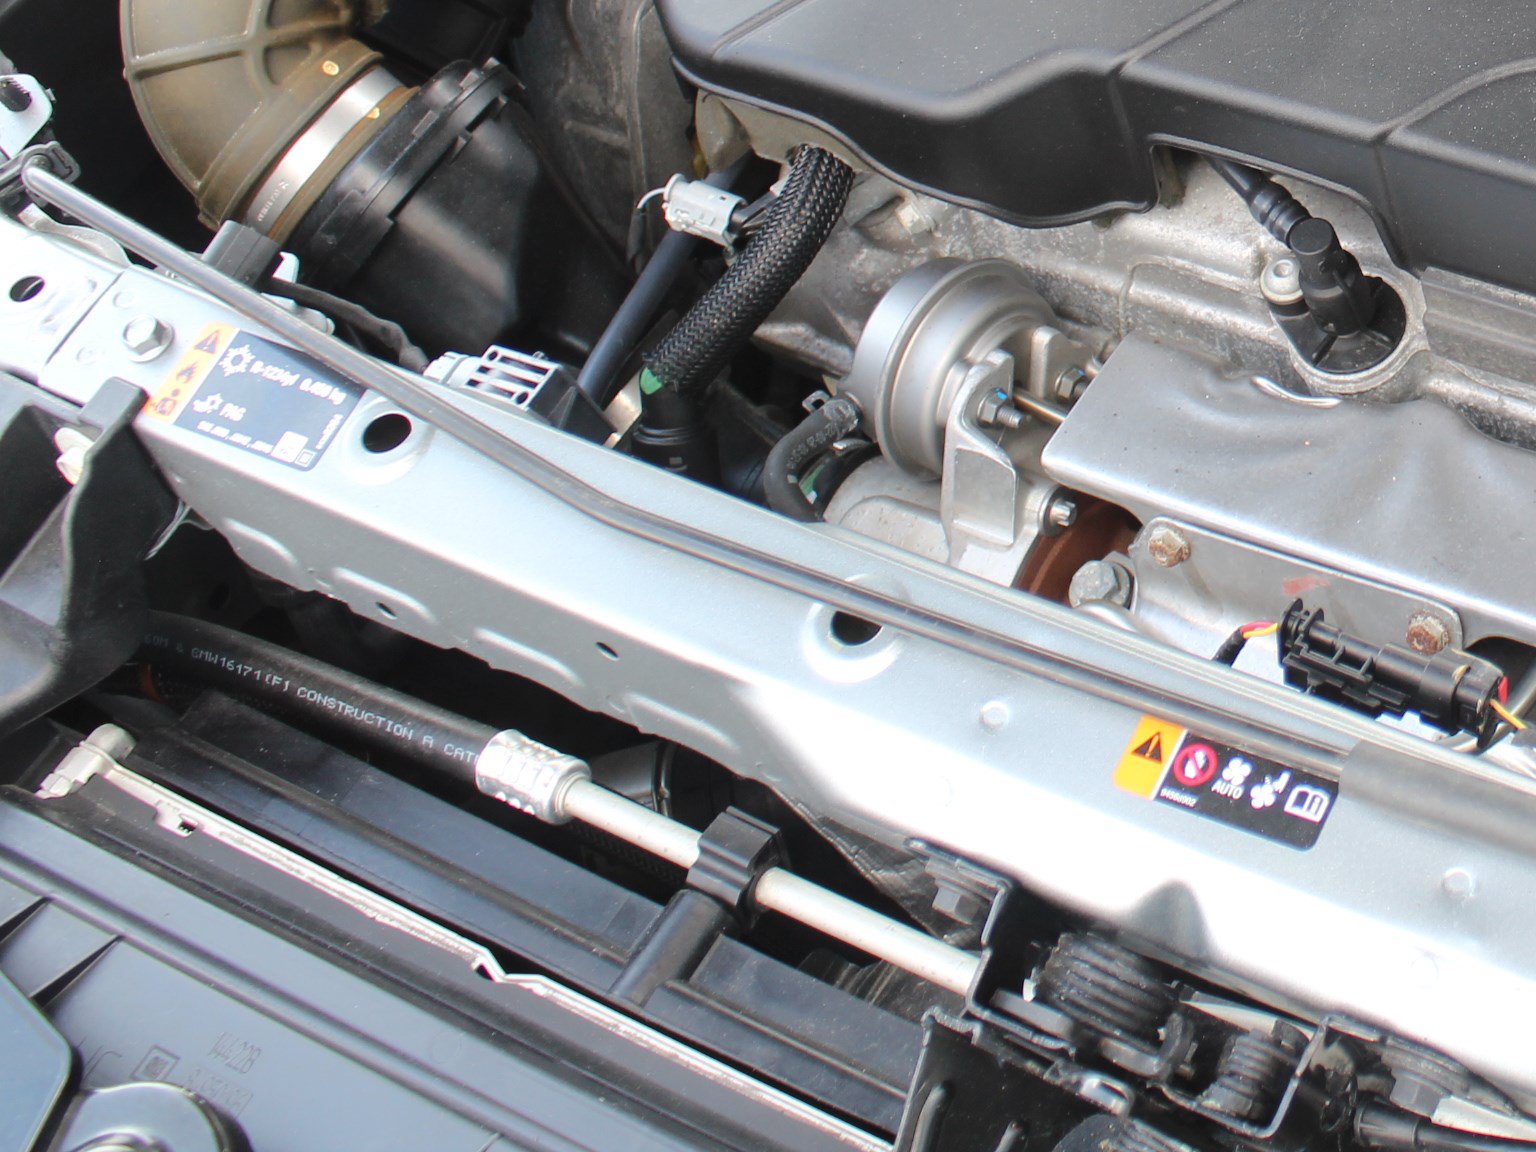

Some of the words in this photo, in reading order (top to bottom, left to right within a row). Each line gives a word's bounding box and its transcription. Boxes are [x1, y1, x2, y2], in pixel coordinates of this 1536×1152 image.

[296, 685, 414, 741] CONSTRUCTION
[422, 734, 434, 748] A
[1210, 780, 1244, 801] AUTO
